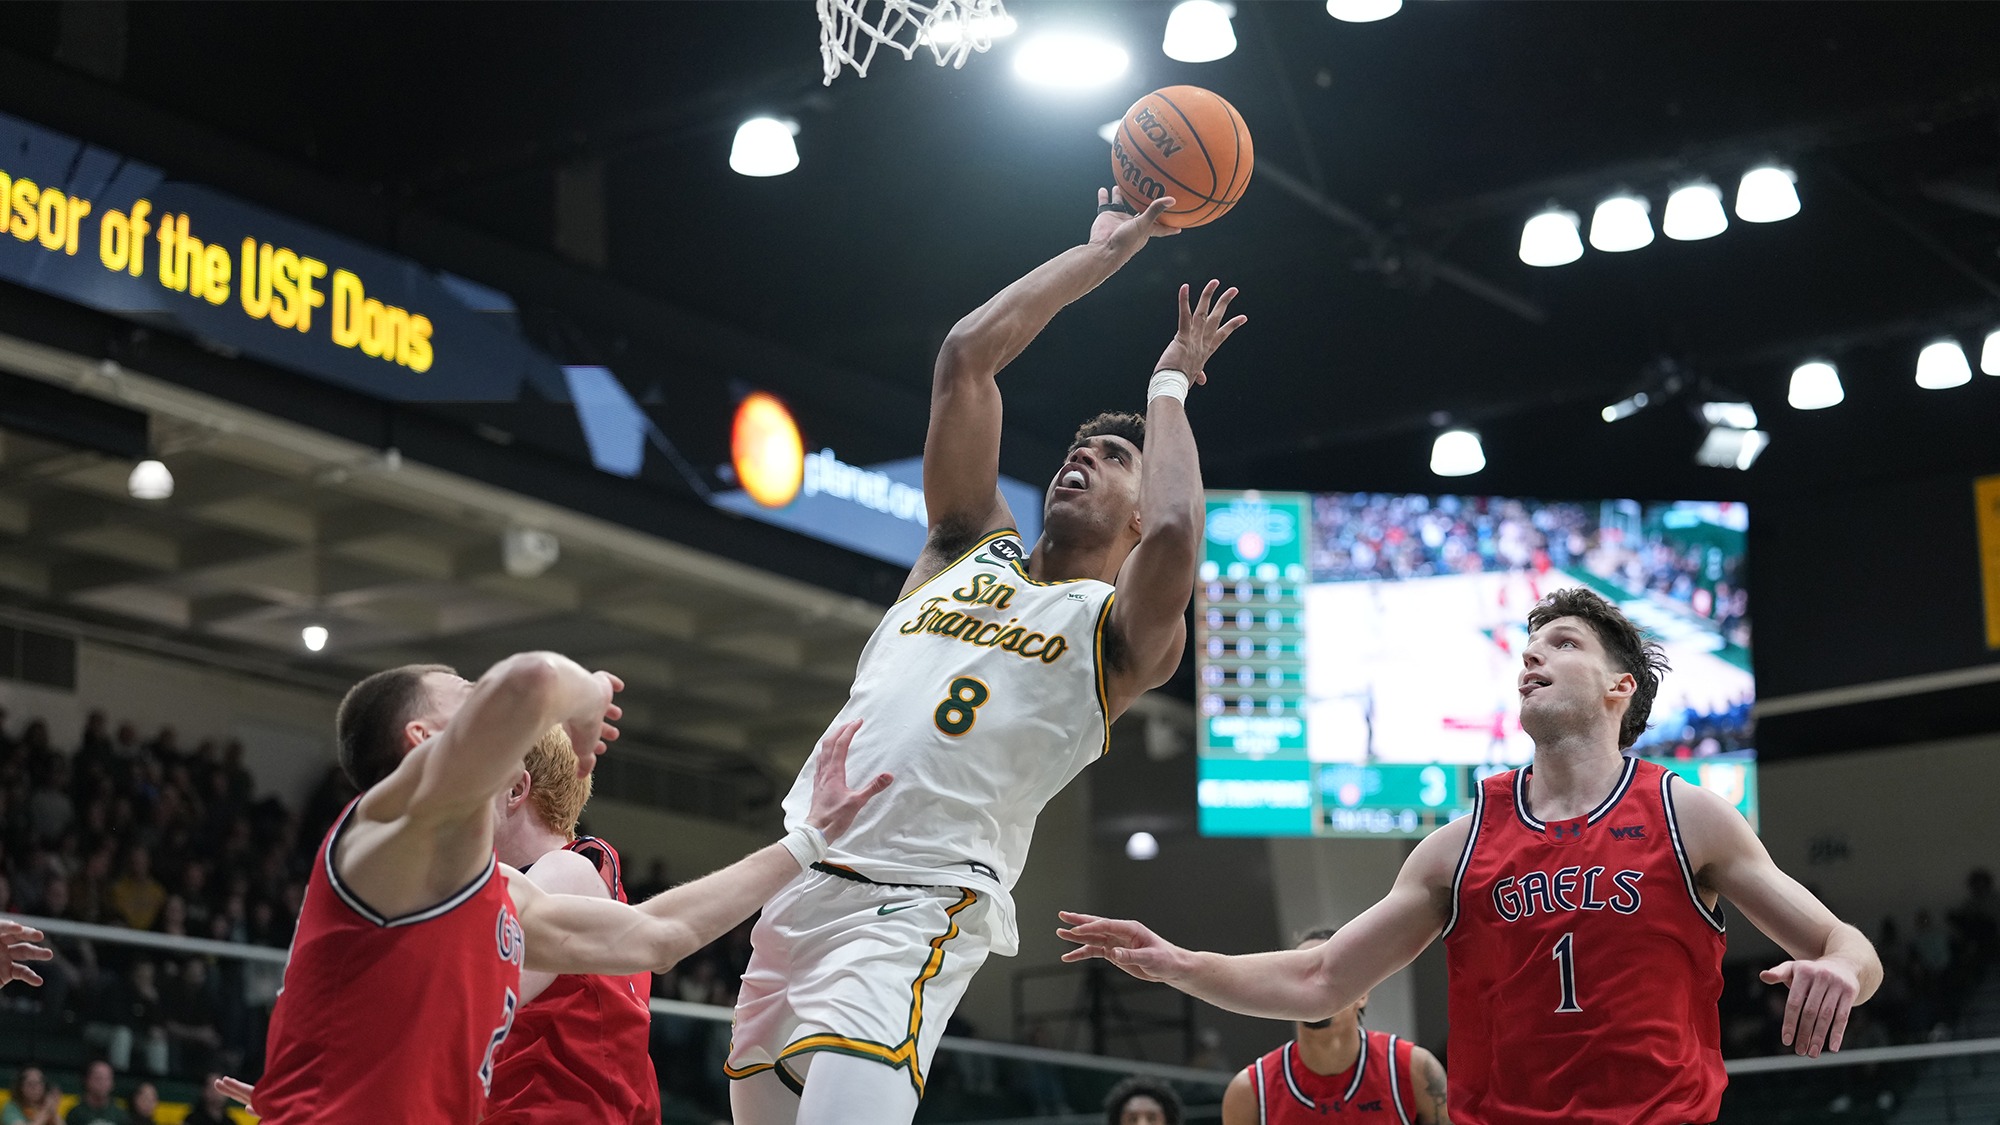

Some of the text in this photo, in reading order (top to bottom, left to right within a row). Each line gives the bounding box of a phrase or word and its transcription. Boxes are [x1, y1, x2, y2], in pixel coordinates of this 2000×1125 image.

[1134, 106, 1182, 159] NCAA
[100, 198, 151, 277] of
[157, 212, 231, 305] the
[240, 237, 327, 333] USF
[332, 269, 433, 373] Dons
[899, 596, 1069, 665] Francisco
[933, 675, 991, 737] 8
[1419, 765, 1446, 807] 3
[1609, 825, 1649, 841] WCC
[1492, 865, 1644, 922] GAELS
[1552, 932, 1583, 1013] 1
